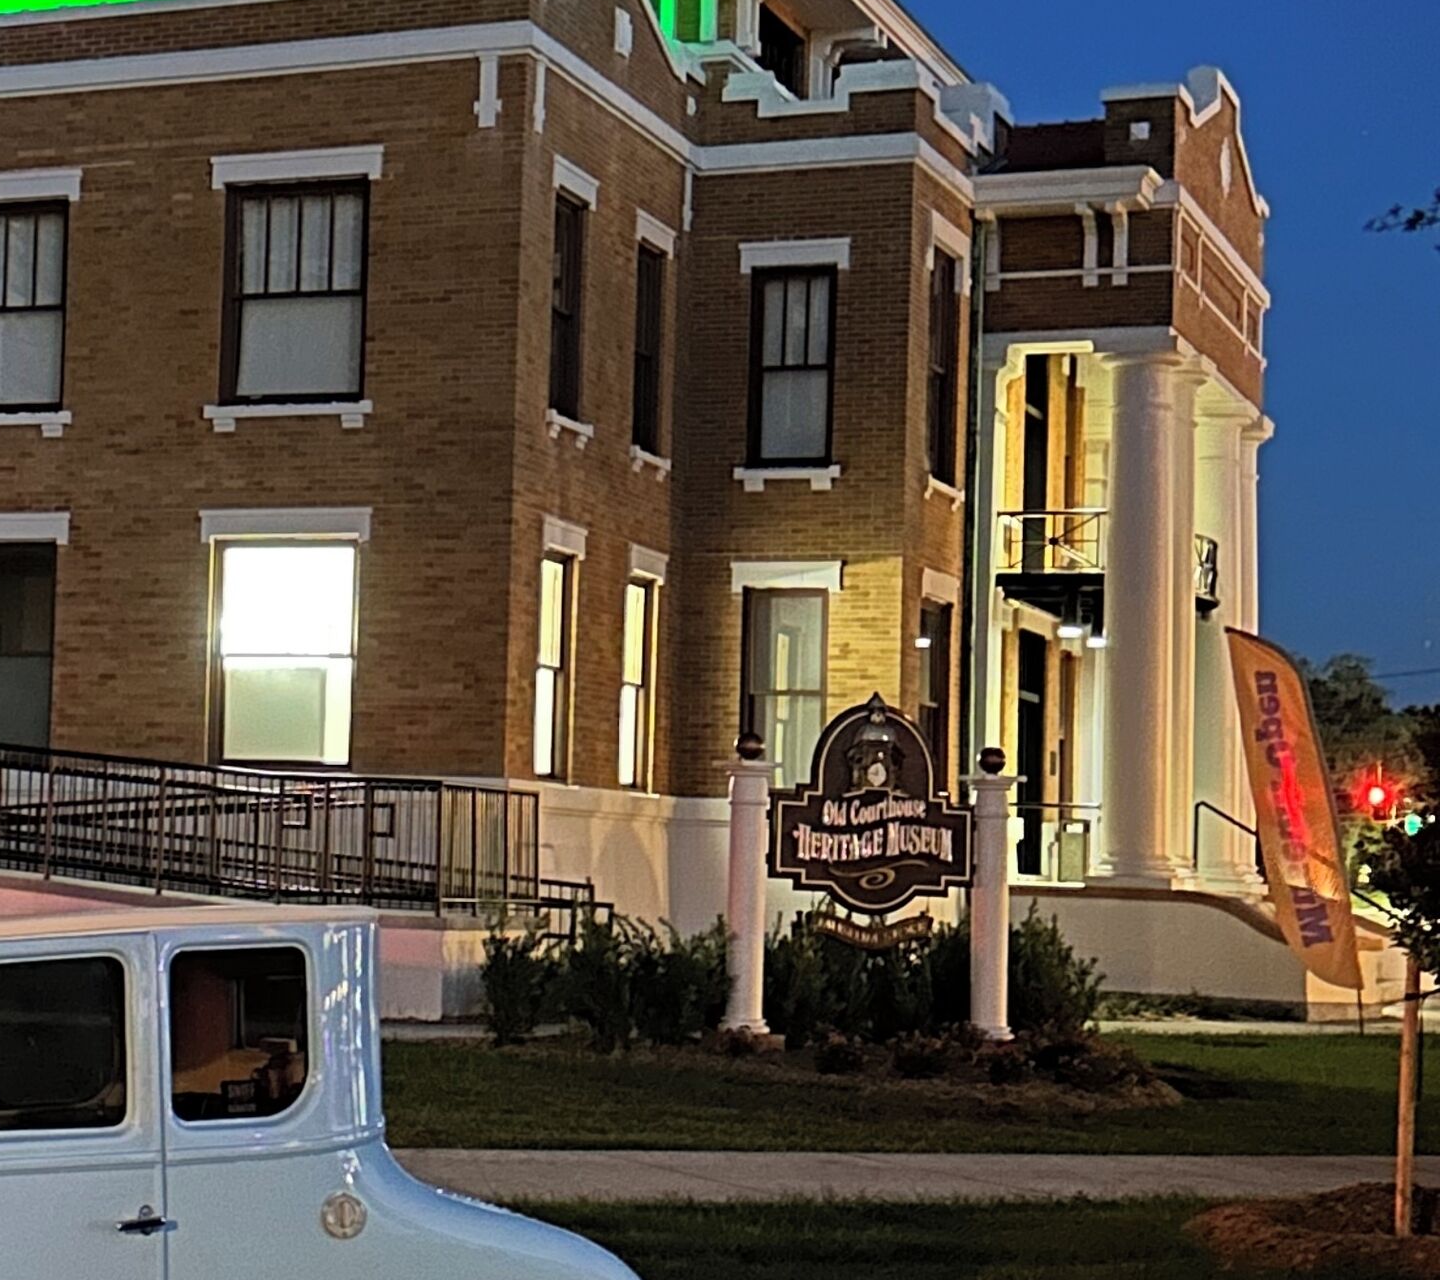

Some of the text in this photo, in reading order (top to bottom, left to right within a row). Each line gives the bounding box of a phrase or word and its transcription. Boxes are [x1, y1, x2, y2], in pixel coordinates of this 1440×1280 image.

[823, 797, 926, 826] Old Courthouse
[793, 821, 952, 863] HERITAGE MUSEUM
